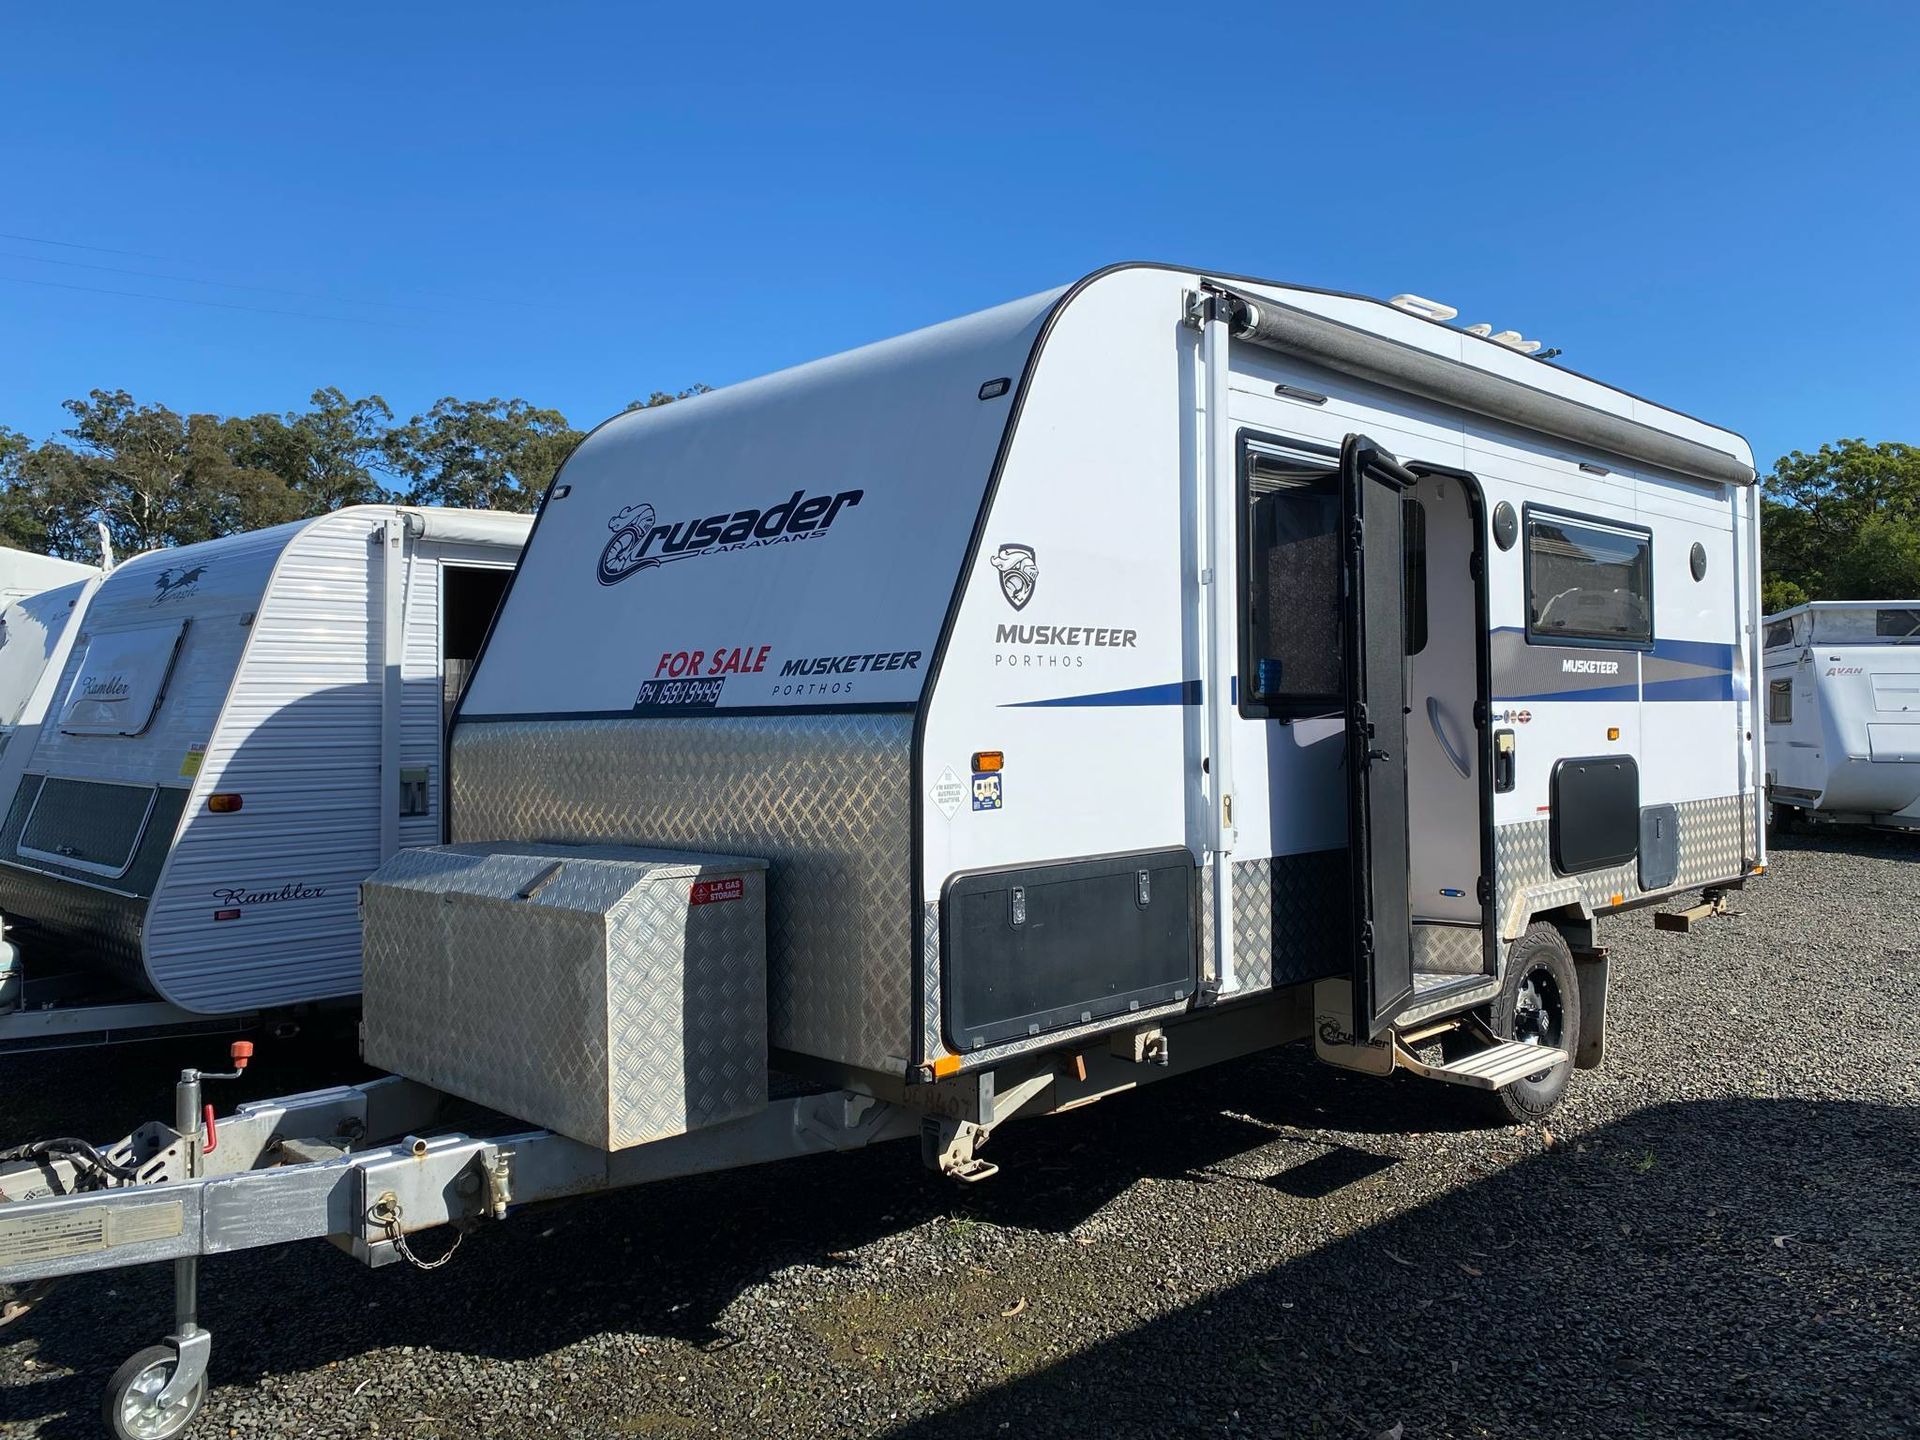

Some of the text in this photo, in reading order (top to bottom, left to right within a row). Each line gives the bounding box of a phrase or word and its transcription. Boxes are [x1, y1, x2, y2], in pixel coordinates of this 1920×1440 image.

[699, 529, 828, 556] CARAVANS
[995, 623, 1137, 649] MUSKETEER
[654, 645, 773, 679] FOR SALE
[779, 651, 922, 676] MUSKETEER
[995, 654, 1084, 668] PORTHOS
[1561, 659, 1619, 674] MUSKETEER
[82, 675, 130, 695] Rambler
[772, 681, 854, 697] PORTHOS
[213, 882, 328, 906] Rambler
[725, 881, 741, 889] GAS
[711, 890, 741, 901] STORAGE
